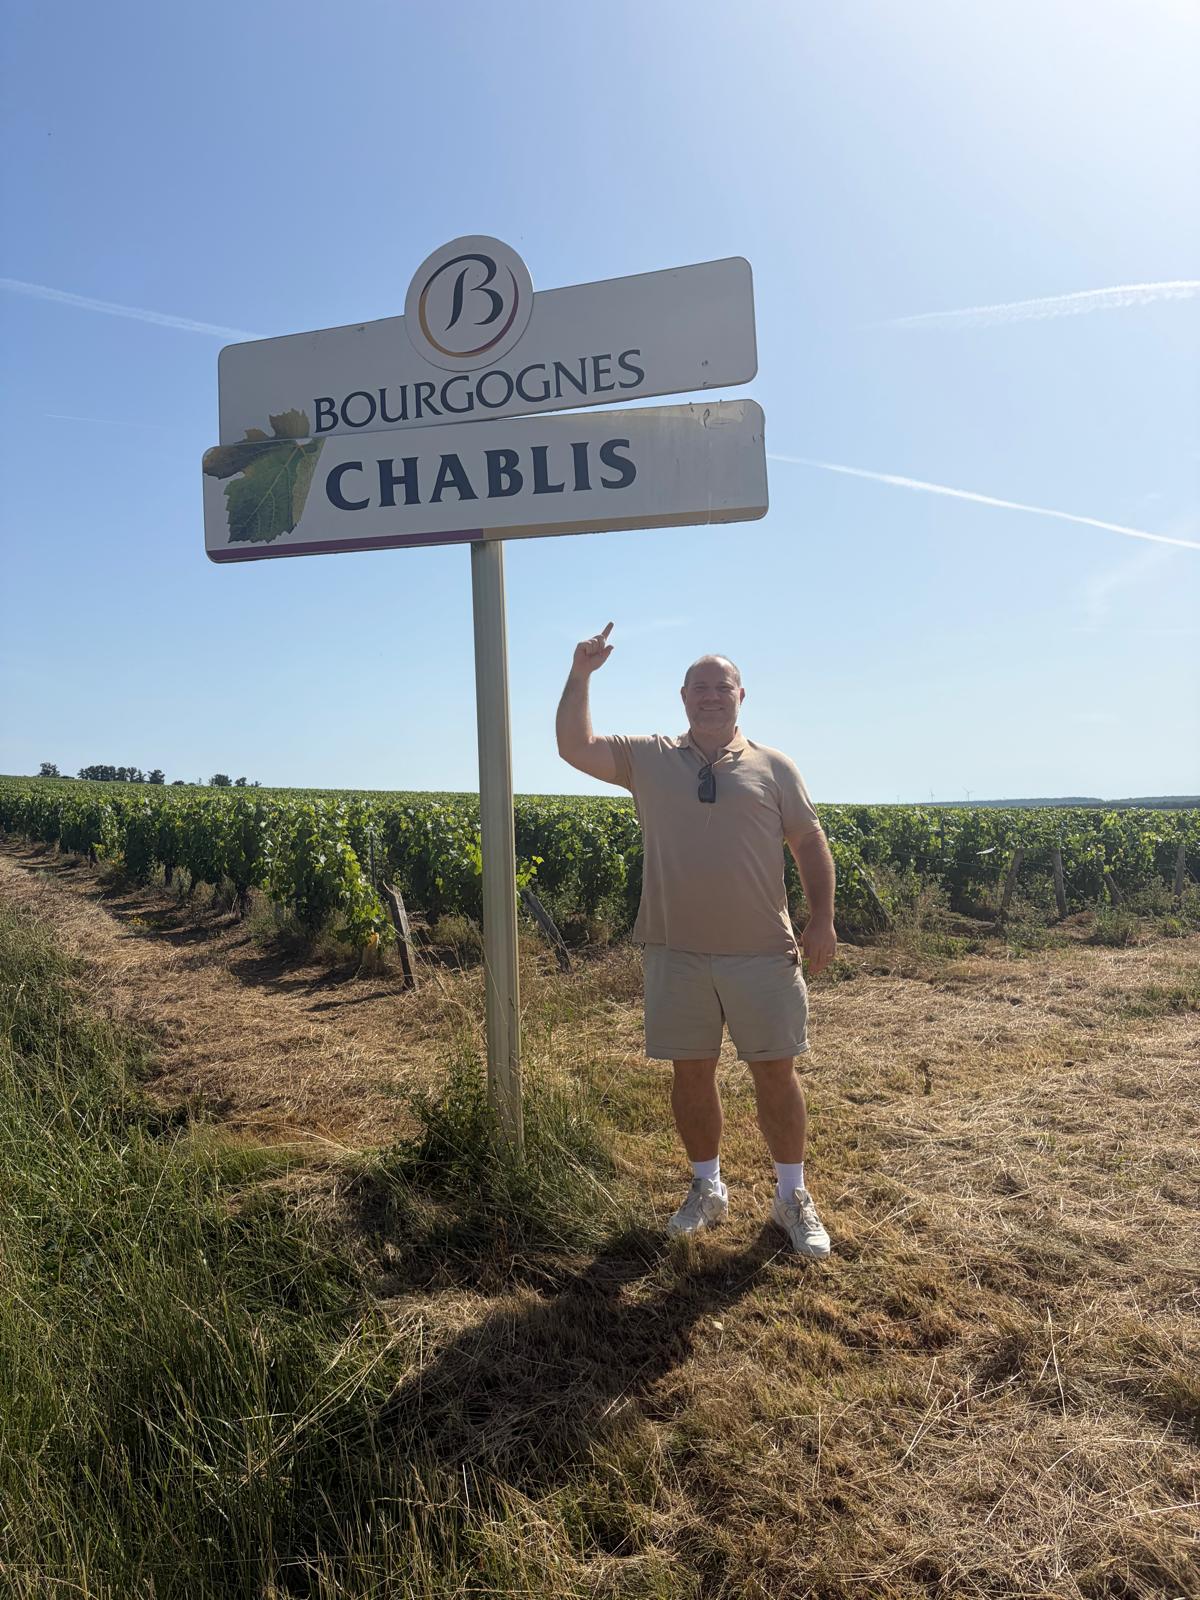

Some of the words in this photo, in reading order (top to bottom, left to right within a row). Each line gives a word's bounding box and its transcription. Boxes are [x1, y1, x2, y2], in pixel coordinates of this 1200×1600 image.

[421, 253, 504, 332] B
[314, 349, 645, 433] BOURGOGNES
[325, 438, 637, 511] CHABLIS
